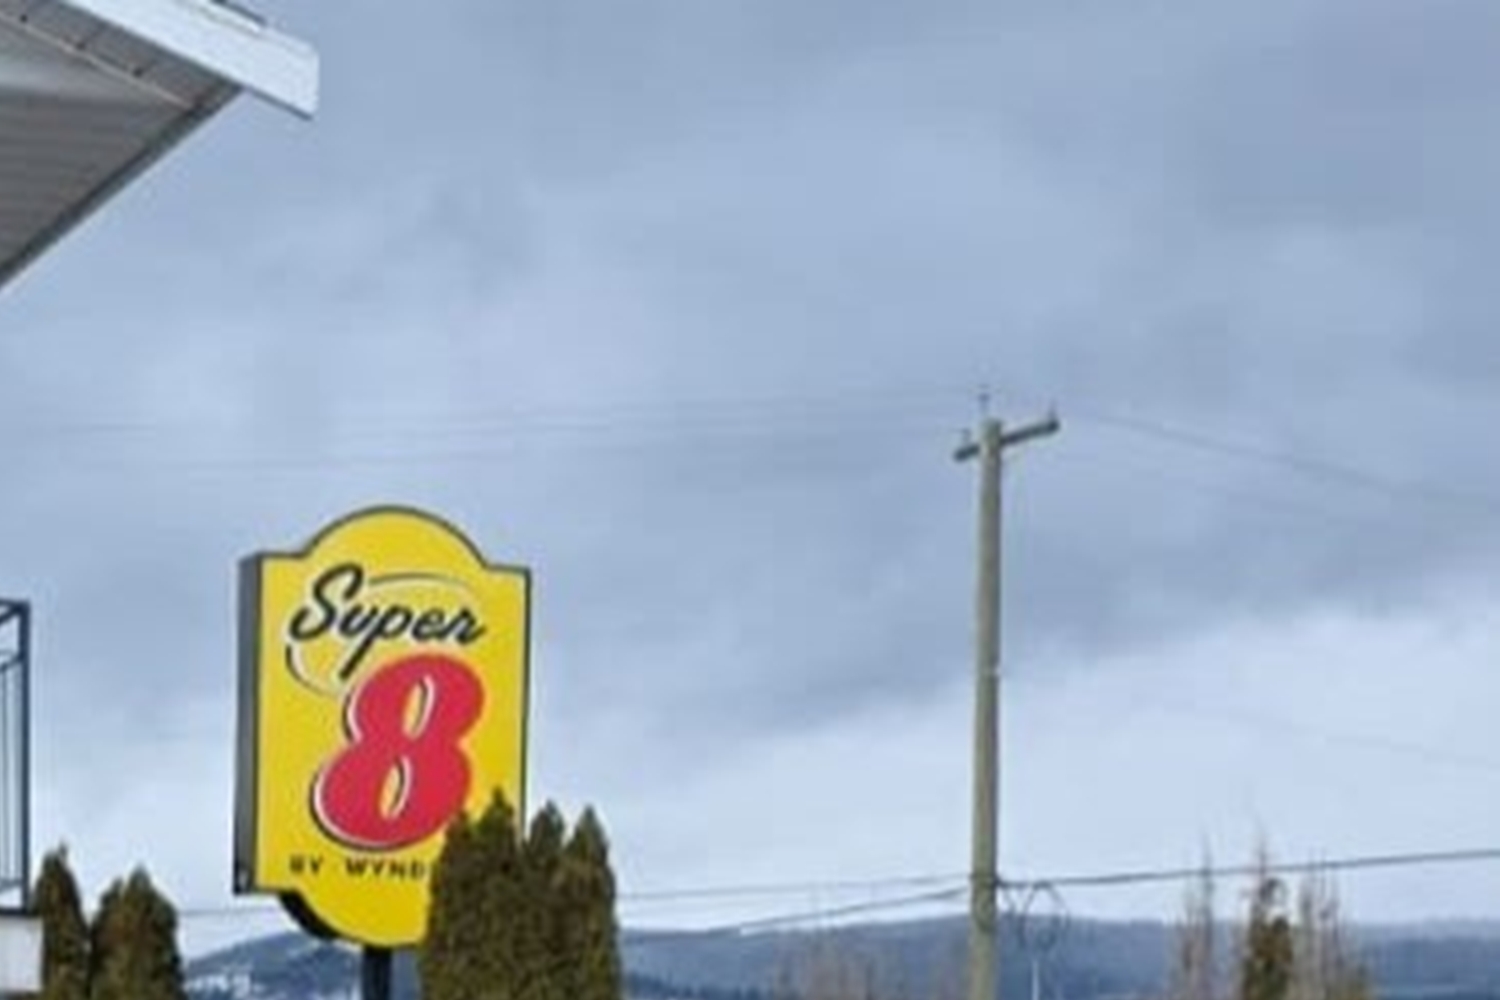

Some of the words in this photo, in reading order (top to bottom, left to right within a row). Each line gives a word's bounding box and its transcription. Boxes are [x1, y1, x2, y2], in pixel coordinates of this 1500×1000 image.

[288, 562, 487, 679] Super
[309, 654, 485, 850] 8
[289, 855, 325, 874] BY
[345, 857, 427, 881] WYND
